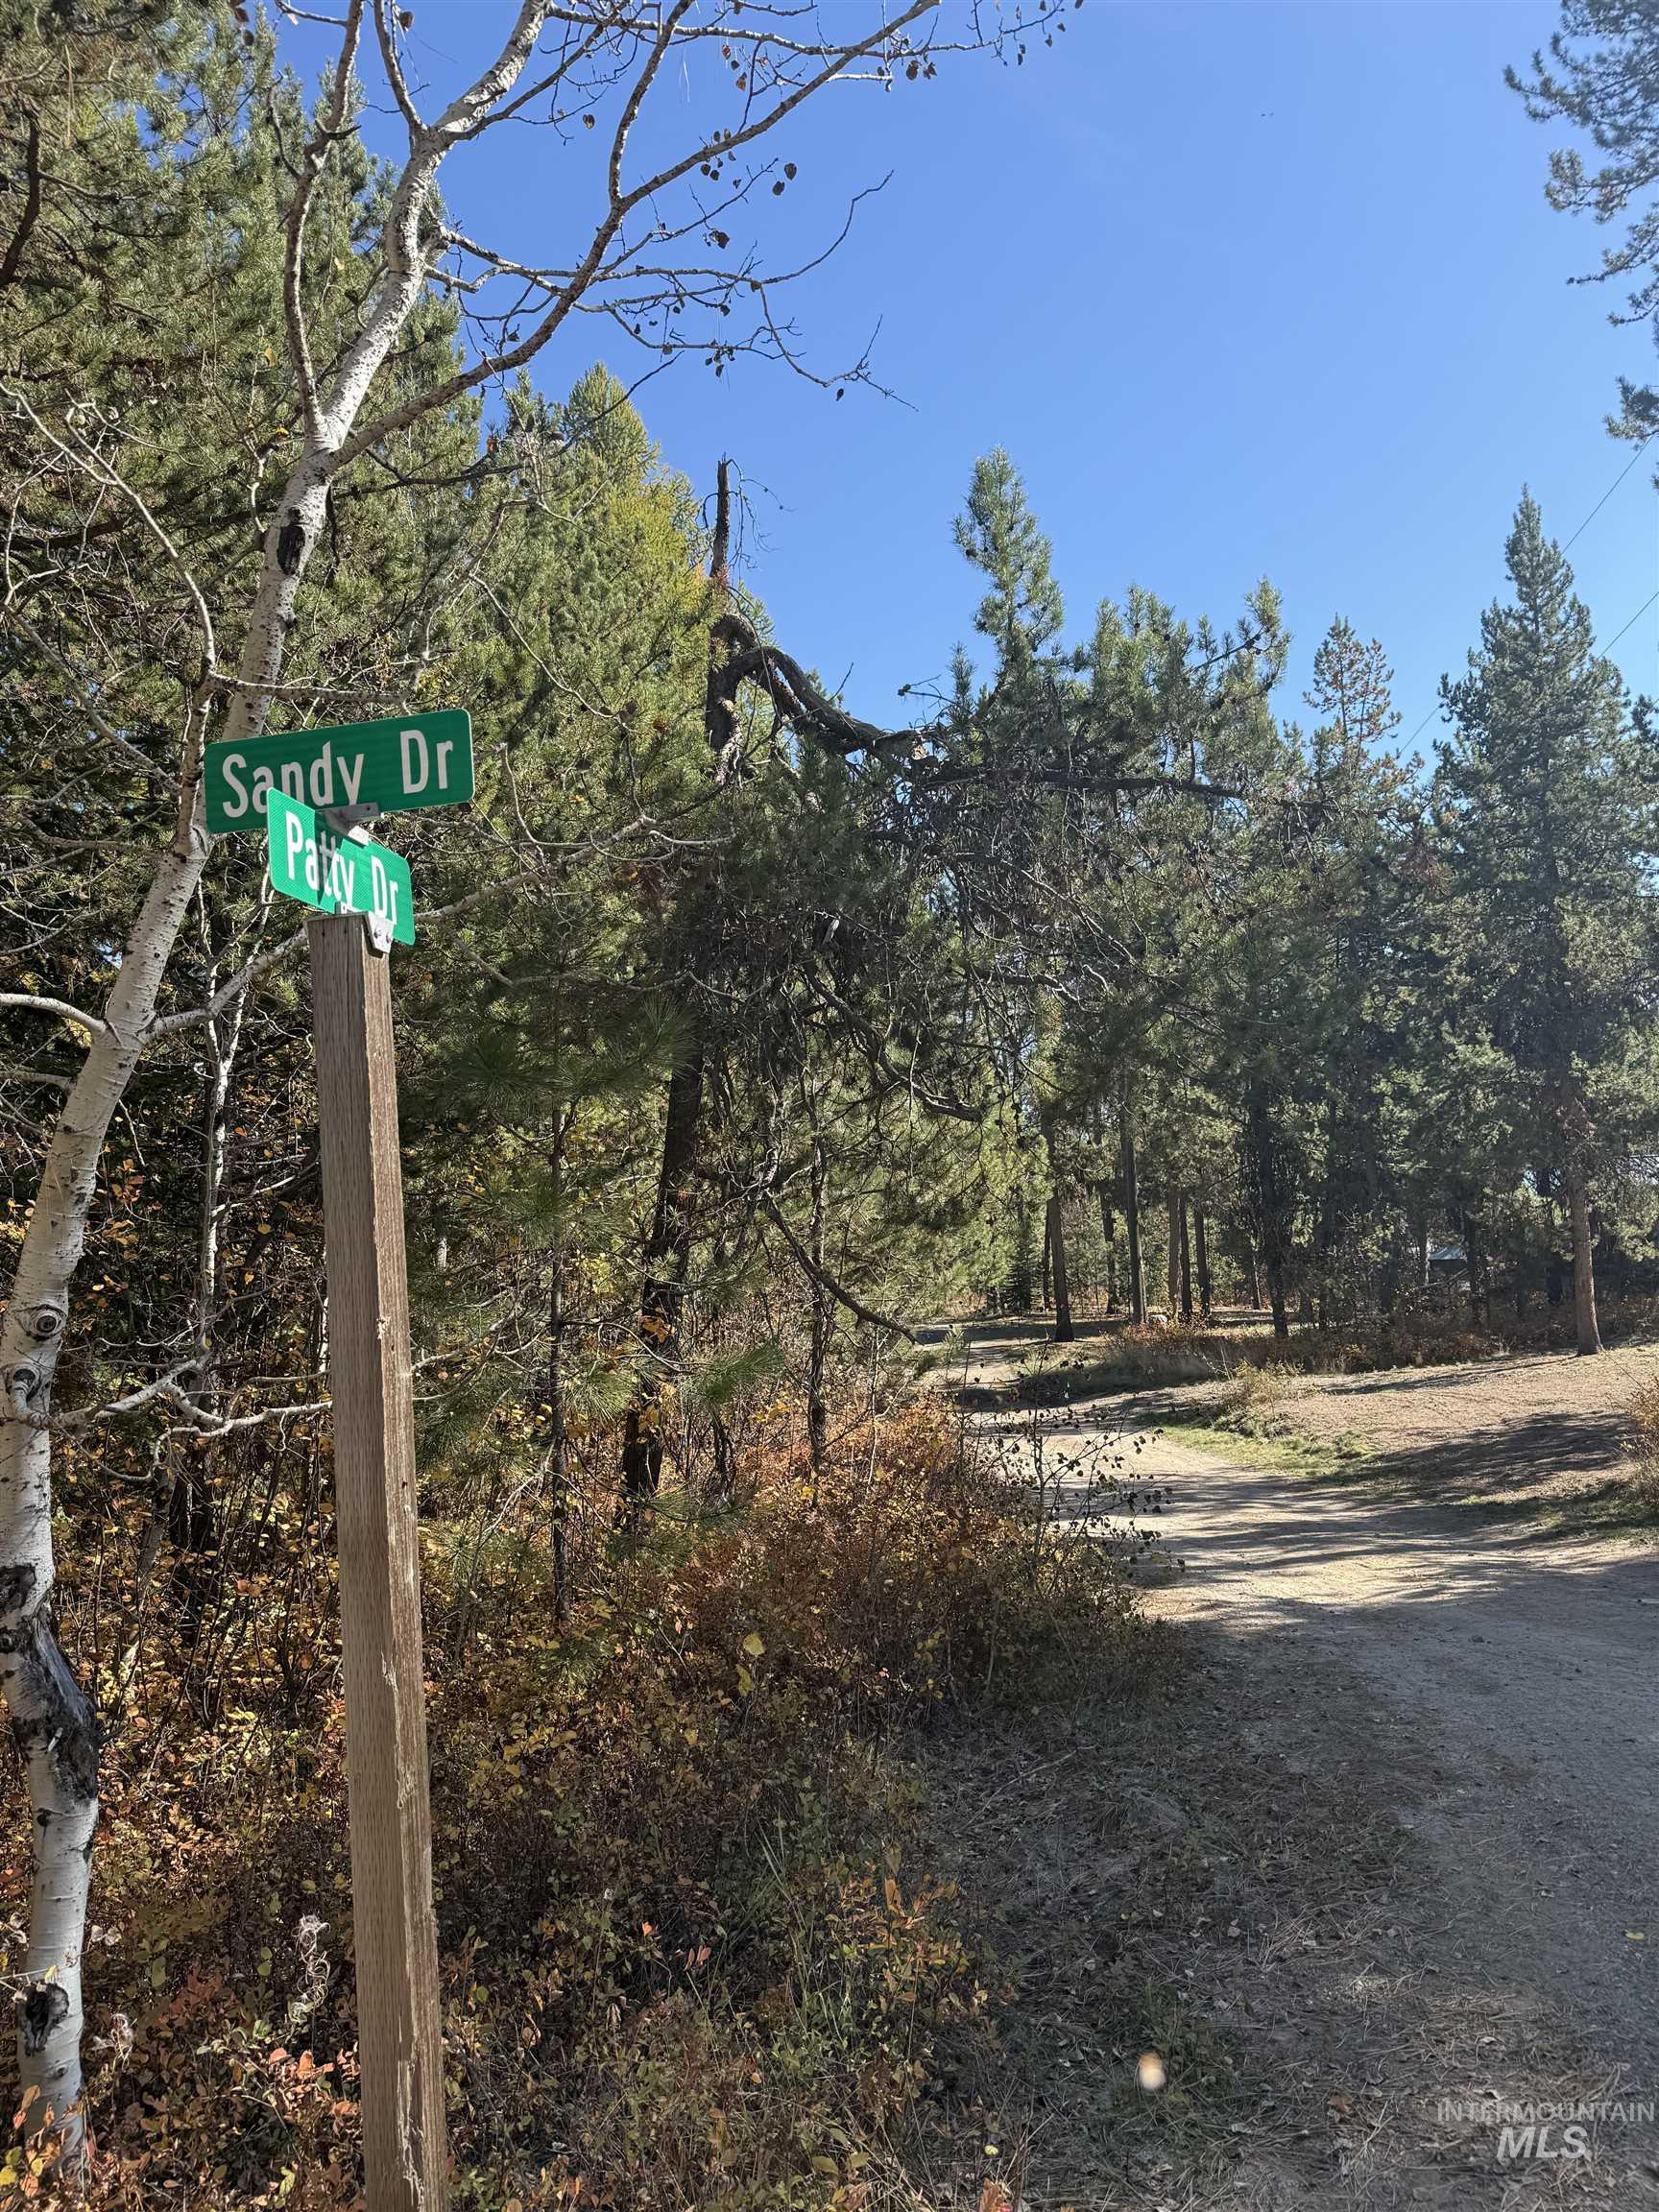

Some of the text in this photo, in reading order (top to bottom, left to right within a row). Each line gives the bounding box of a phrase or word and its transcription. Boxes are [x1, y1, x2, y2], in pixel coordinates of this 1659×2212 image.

[223, 730, 453, 817] Sandy Dr
[285, 810, 398, 926] Patty Dr
